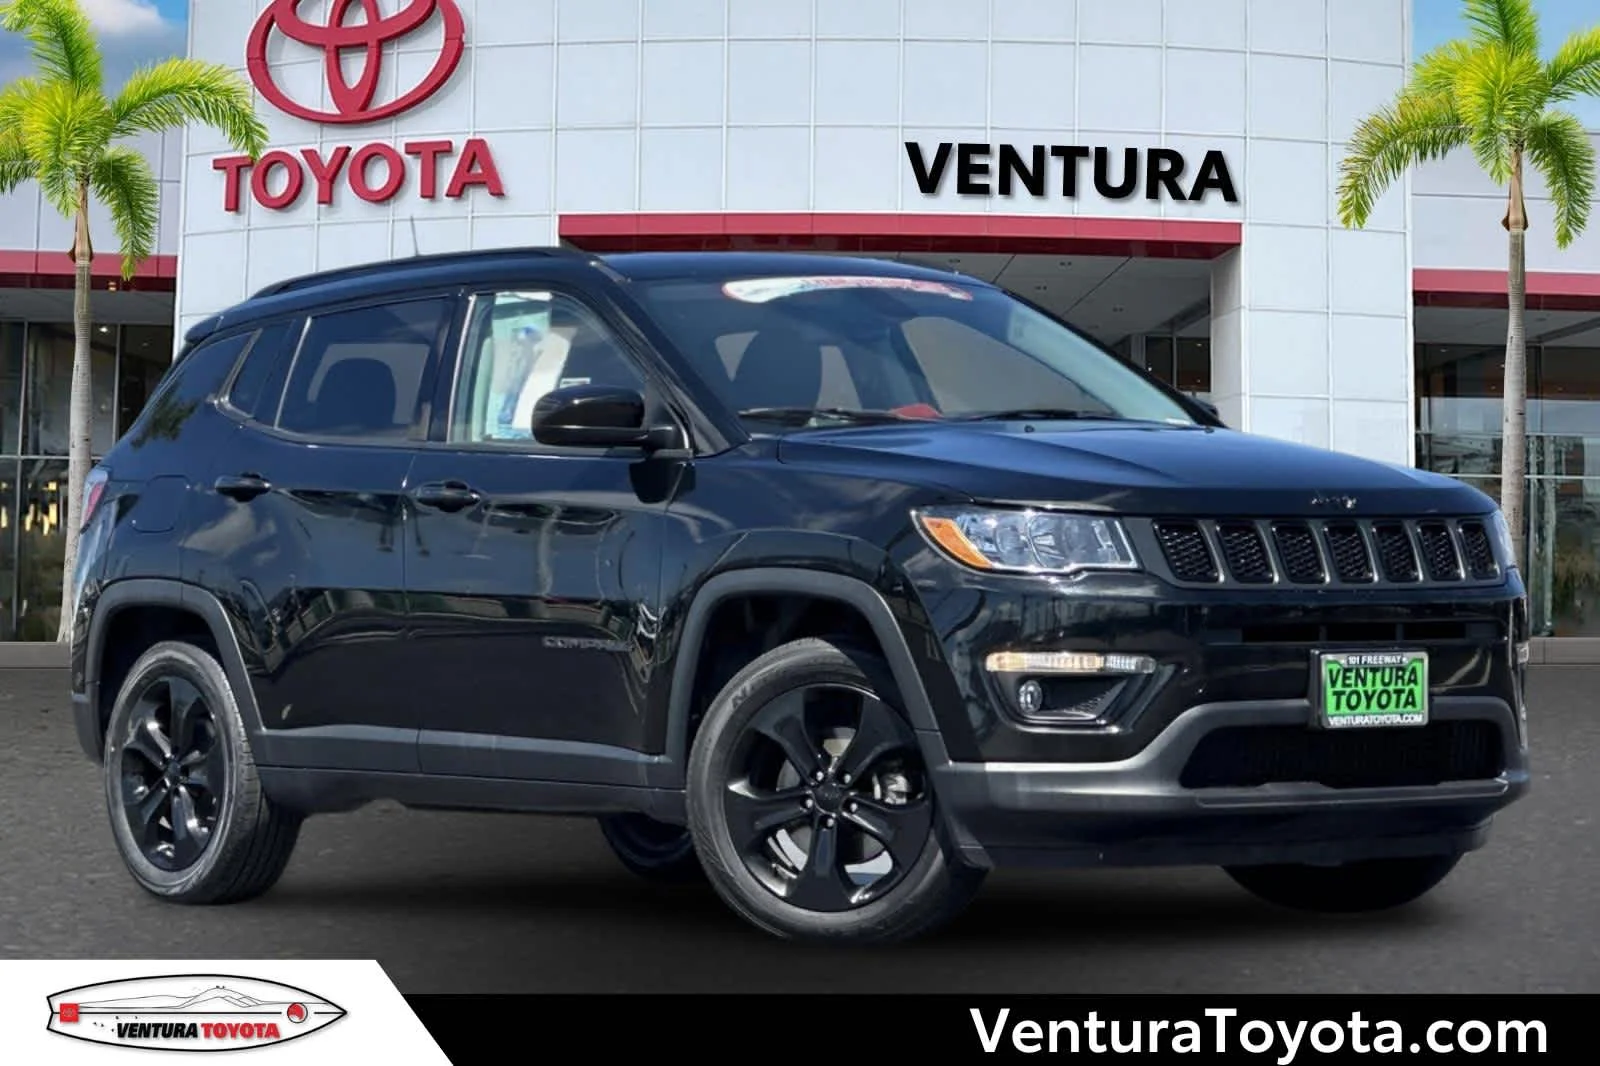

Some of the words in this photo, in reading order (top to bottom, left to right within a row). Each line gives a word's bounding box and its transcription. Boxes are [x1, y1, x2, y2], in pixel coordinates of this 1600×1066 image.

[213, 138, 505, 213] TOYOTA
[904, 141, 1238, 203] VENTURA
[542, 636, 633, 651] COMPA
[1348, 655, 1360, 665] 101
[1361, 655, 1402, 665] FREEWAY
[1328, 666, 1419, 688] VENTURA
[1332, 688, 1417, 711] TOYOTA
[1328, 713, 1423, 727] VENTURATOYOTA.COM
